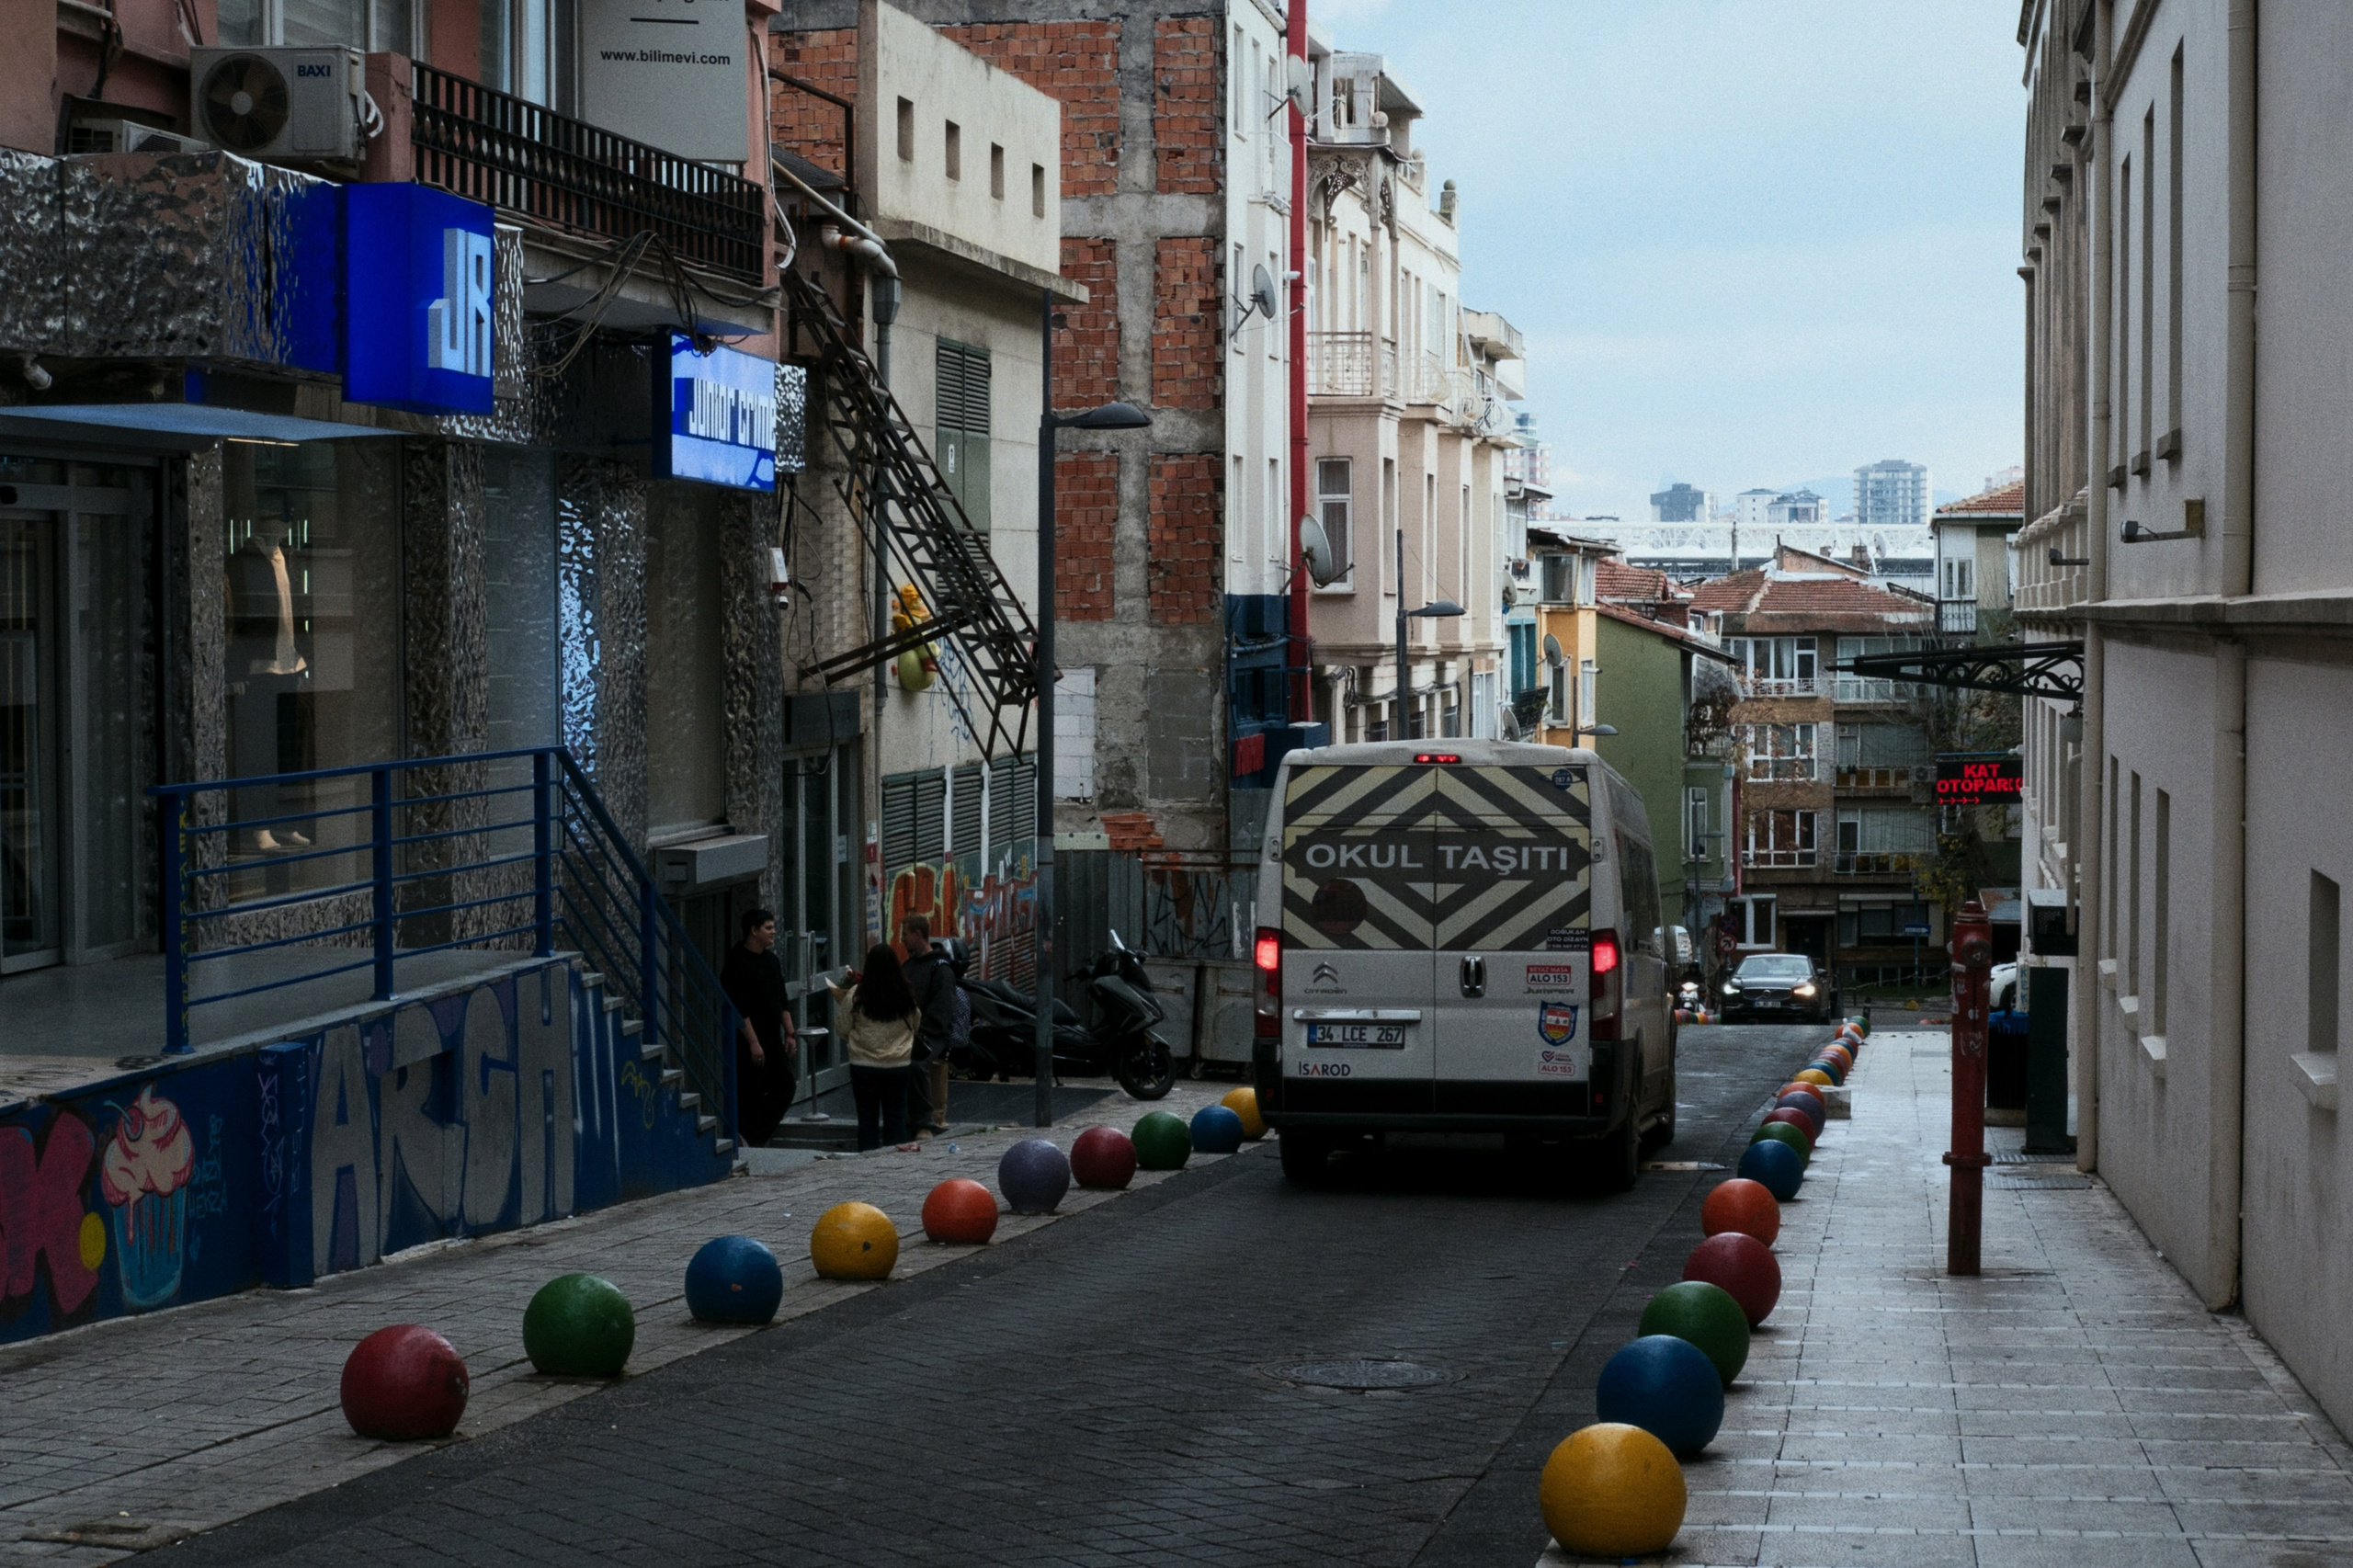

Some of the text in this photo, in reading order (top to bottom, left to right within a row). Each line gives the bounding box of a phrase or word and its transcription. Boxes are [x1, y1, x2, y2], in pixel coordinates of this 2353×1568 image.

[600, 50, 731, 65] www.bilimevi.com
[297, 64, 331, 77] BAXI
[428, 227, 491, 379] JR
[1962, 763, 2001, 778] KAT
[1305, 844, 1568, 876] OKUL TAŞITI
[1530, 974, 1568, 983] ALO 153
[1317, 1026, 1334, 1041] 34
[1342, 1026, 1368, 1042] LCE
[1377, 1027, 1403, 1042] 267
